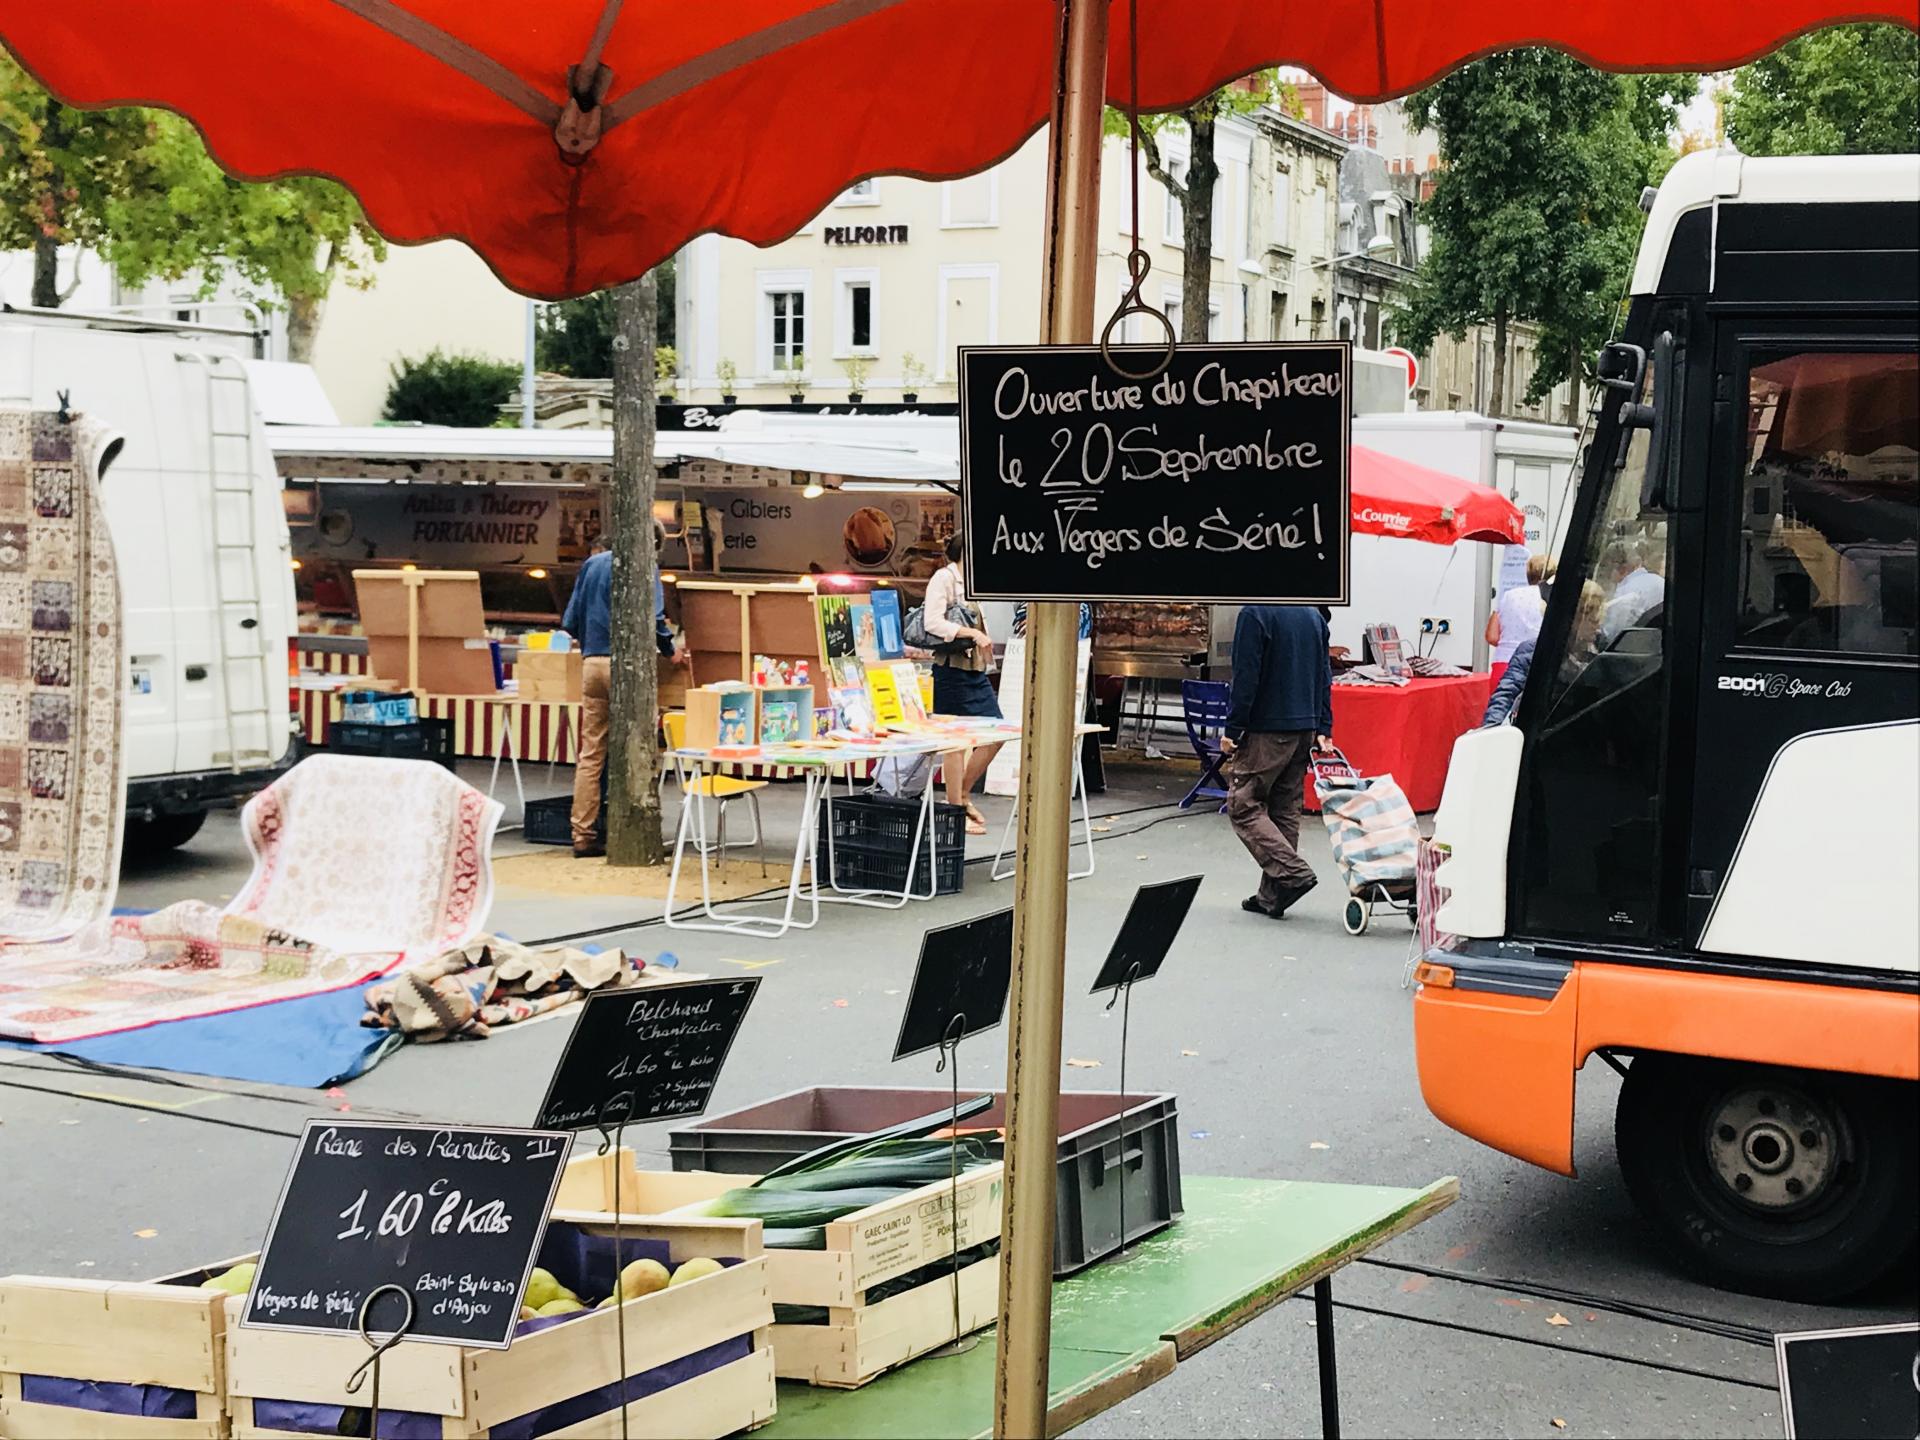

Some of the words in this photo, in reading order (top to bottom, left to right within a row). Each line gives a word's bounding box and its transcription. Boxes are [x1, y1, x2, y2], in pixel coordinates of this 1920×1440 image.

[994, 366, 1145, 420] Ouverture
[1151, 371, 1186, 406] du
[1193, 362, 1342, 410] Chapiteau
[999, 434, 1027, 488] le
[1040, 422, 1114, 487] 20
[1118, 422, 1324, 483] Septembre
[480, 493, 549, 520] Thierry
[1361, 508, 1412, 526] Courrier
[413, 520, 539, 544] FORTANNIER
[992, 514, 1045, 555] Aux
[1053, 508, 1141, 569] Vergers
[1148, 515, 1189, 549] de
[1786, 678, 1823, 698] Space
[1825, 680, 1852, 698] Cab
[376, 701, 406, 716] VIE
[607, 1054, 658, 1080] 1,60
[384, 1135, 418, 1157] des
[337, 1188, 424, 1241] 1,60
[431, 1190, 461, 1235] le
[936, 1218, 968, 1237] POIRAUX
[459, 1273, 515, 1296] Sylvain
[257, 1286, 298, 1317] Vergers
[300, 1290, 320, 1311] de
[432, 1297, 493, 1324] d'Anjou
